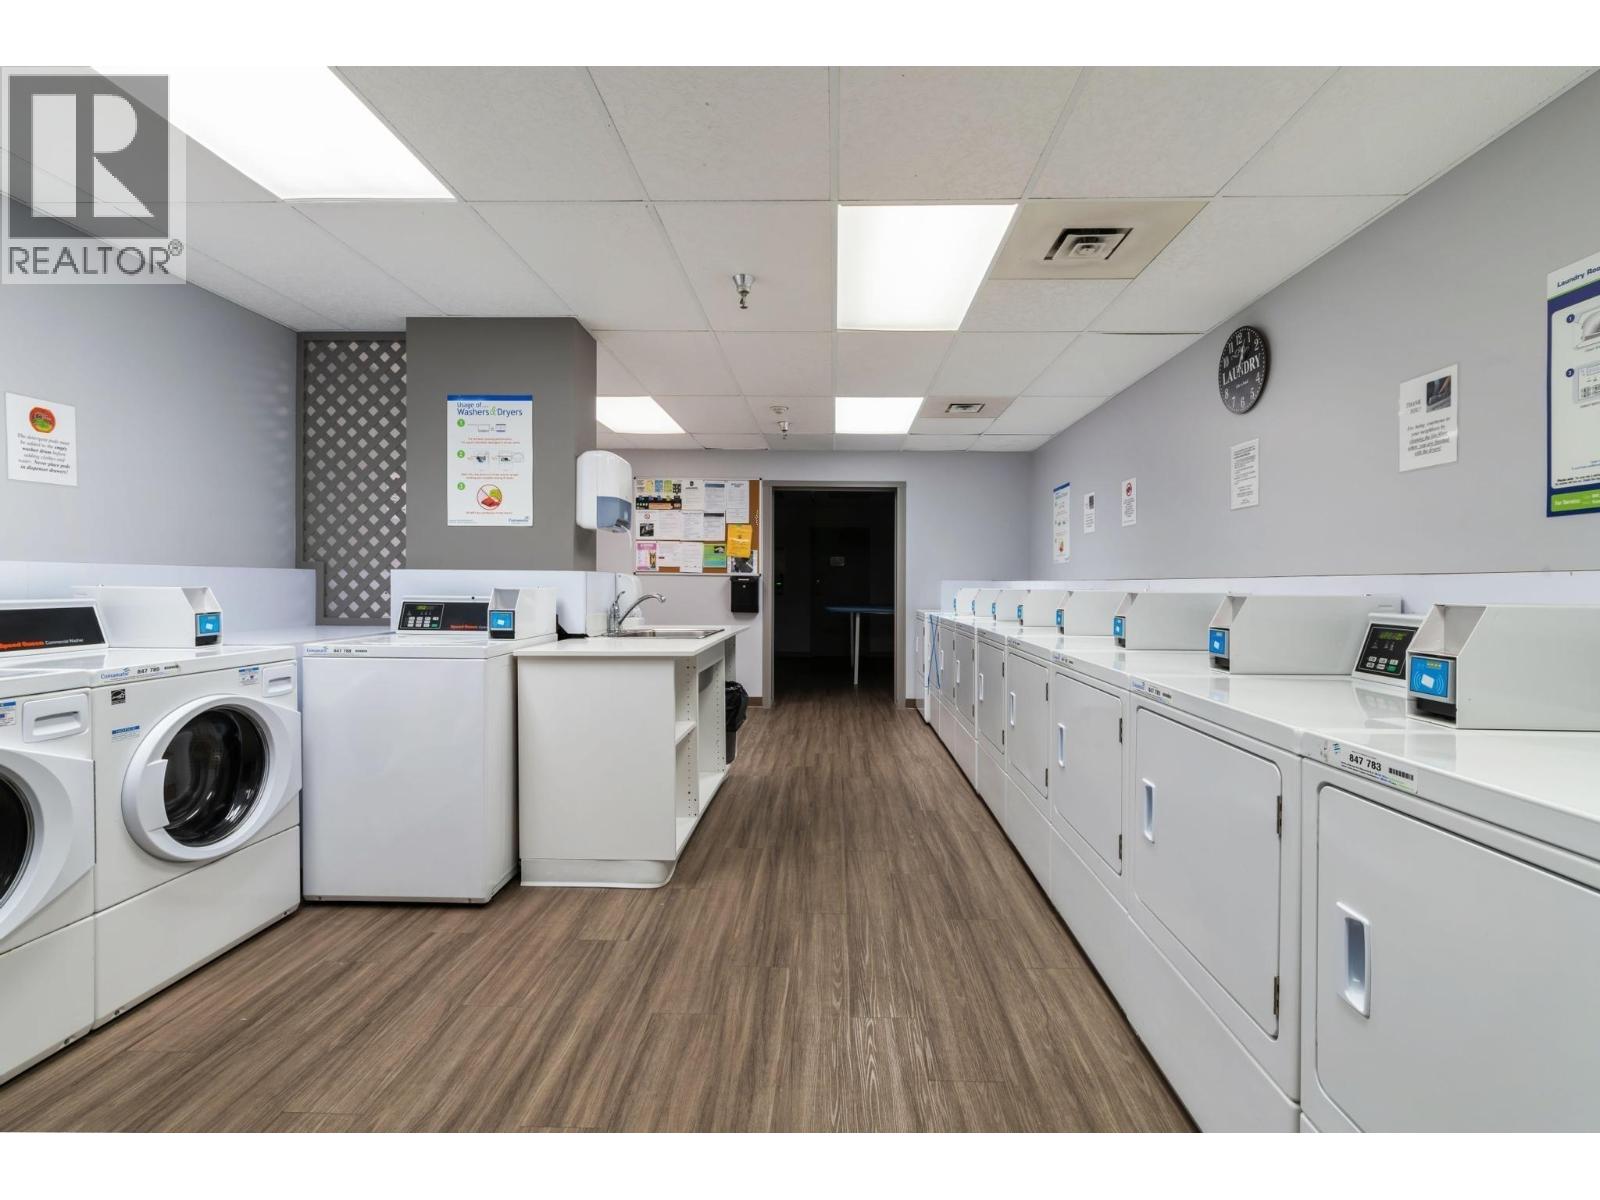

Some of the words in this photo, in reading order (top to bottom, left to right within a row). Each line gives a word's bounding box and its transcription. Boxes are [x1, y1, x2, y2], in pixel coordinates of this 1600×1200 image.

[1557, 273, 1585, 288] Laundry
[1222, 354, 1261, 385] LAUNDRY
[456, 402, 475, 410] Usage
[457, 407, 488, 416] Washers
[488, 406, 495, 417] &
[495, 408, 522, 418] Dryers
[1349, 753, 1364, 766] 847
[1366, 759, 1382, 772] 783
